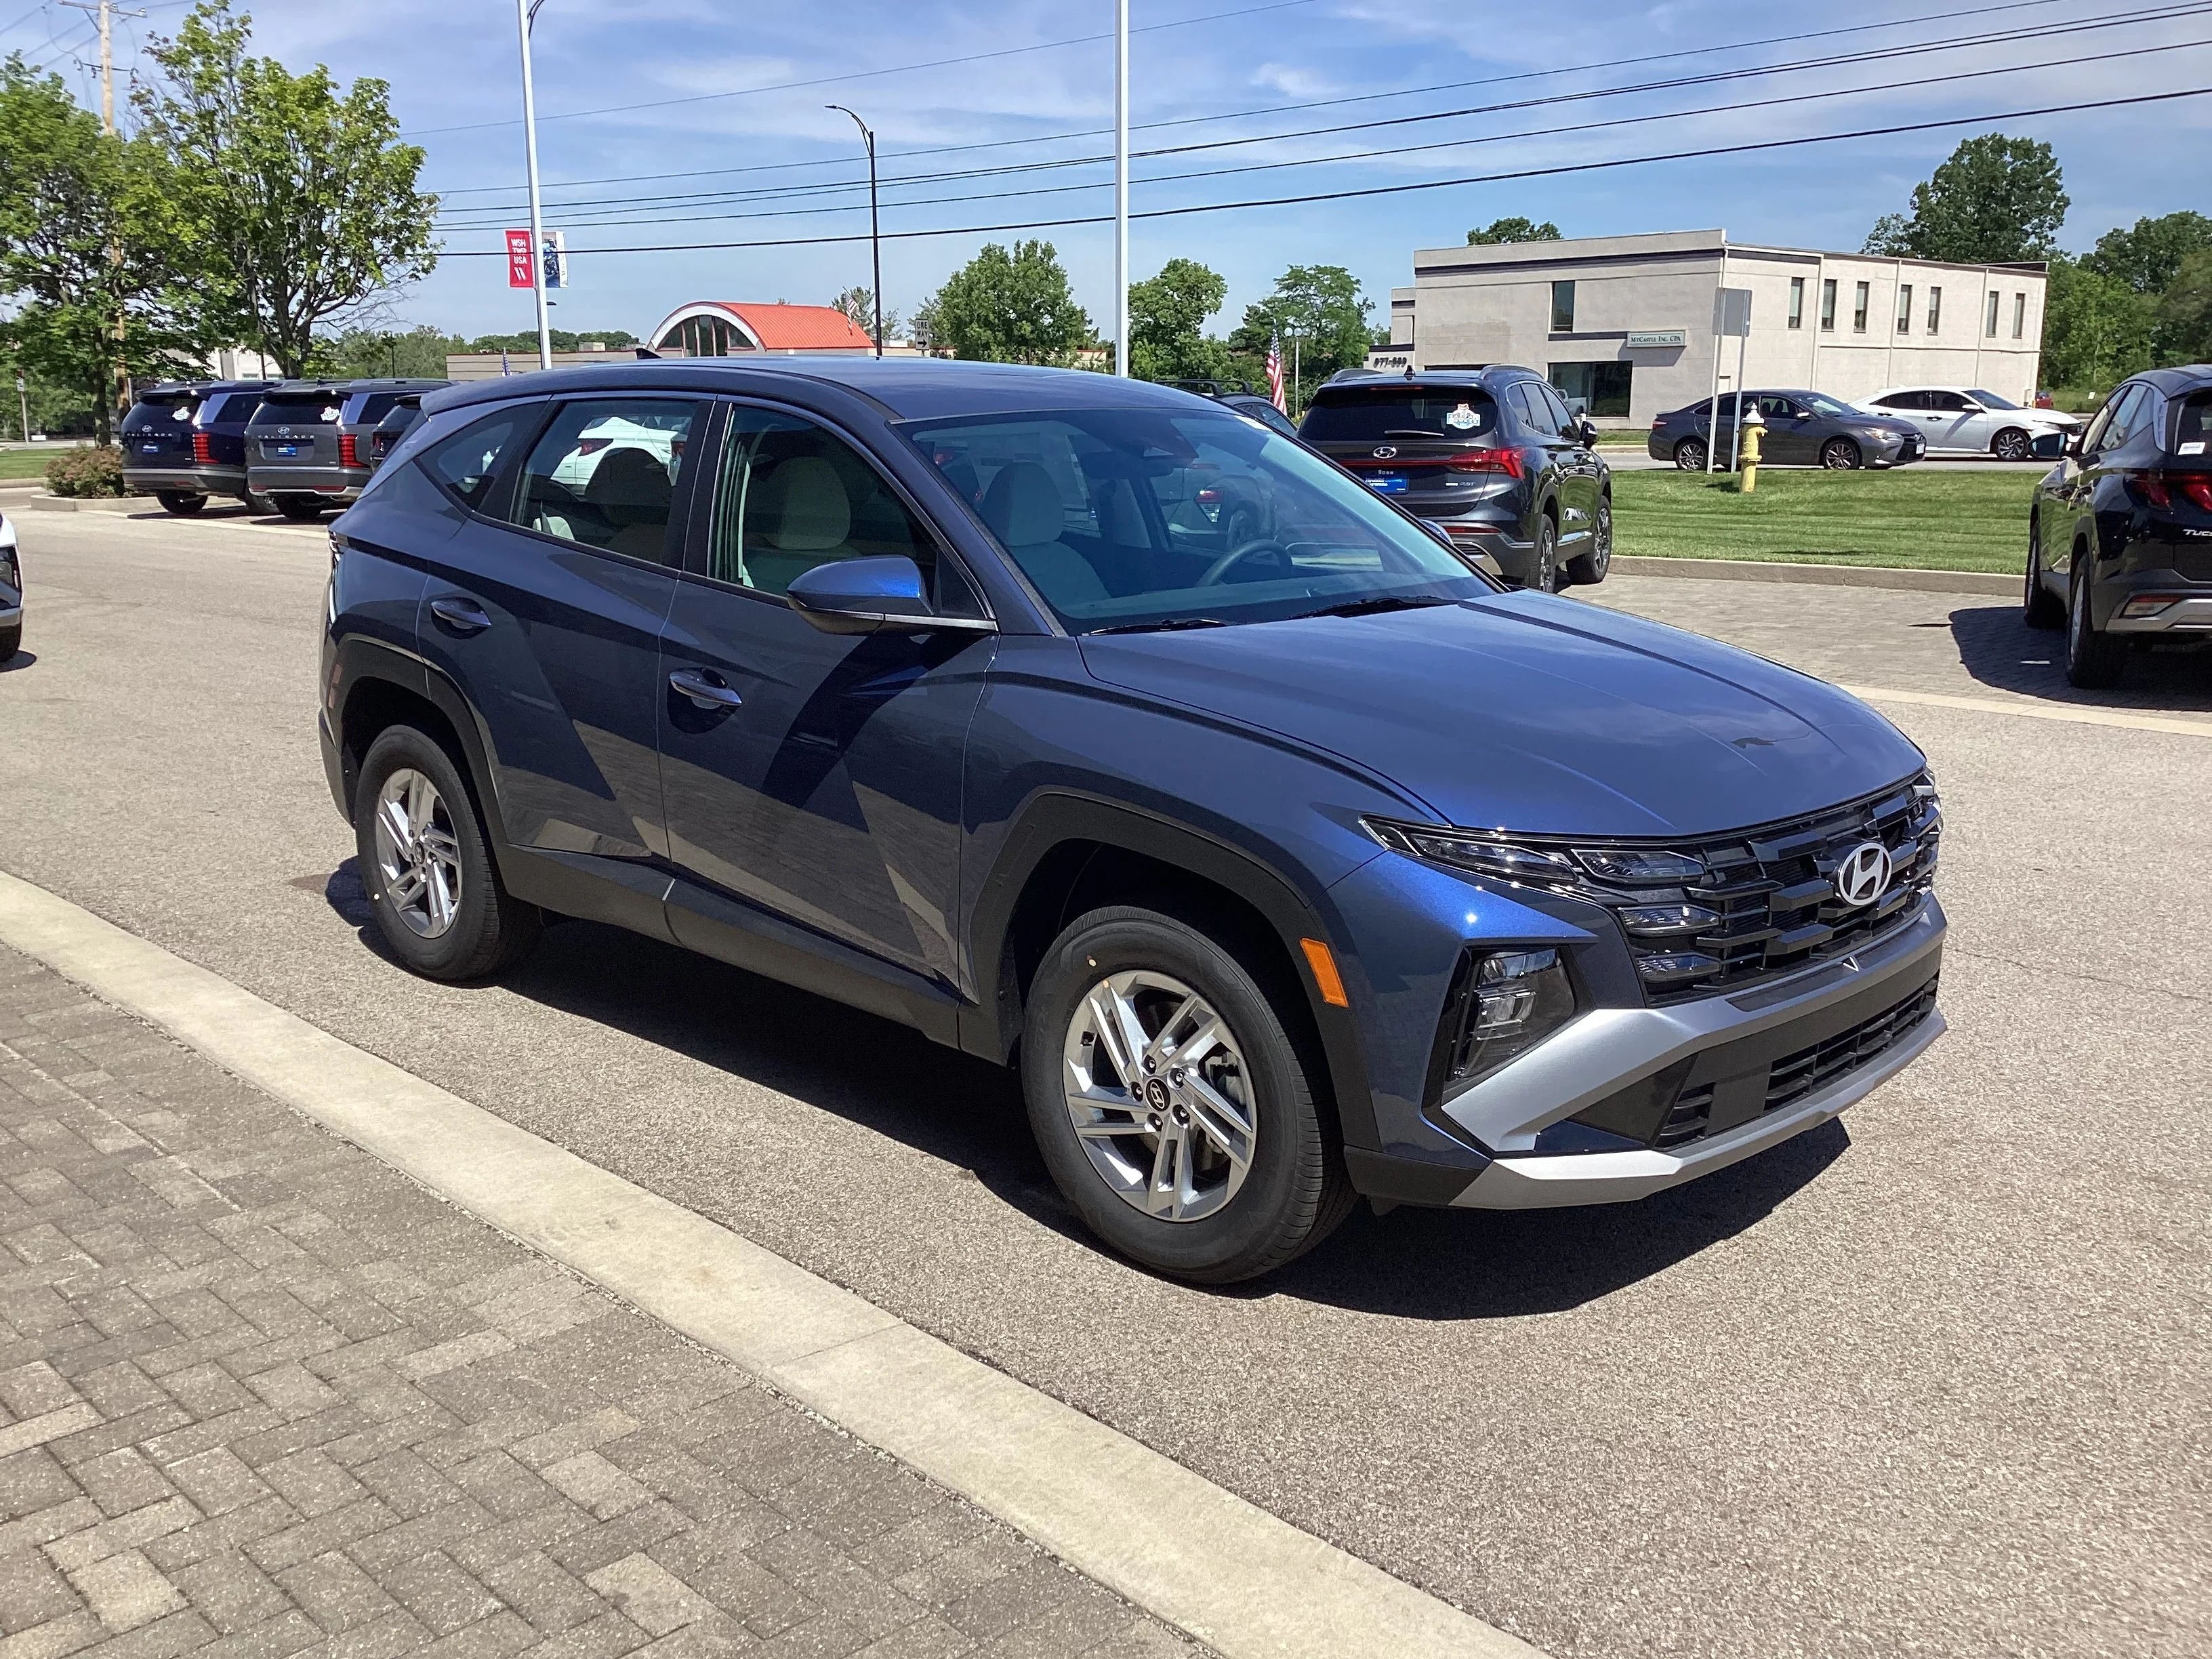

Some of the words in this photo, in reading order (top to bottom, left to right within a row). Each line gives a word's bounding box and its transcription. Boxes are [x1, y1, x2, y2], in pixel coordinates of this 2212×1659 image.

[510, 238, 527, 247] WSH
[513, 255, 527, 264] USA
[916, 321, 928, 329] ONE
